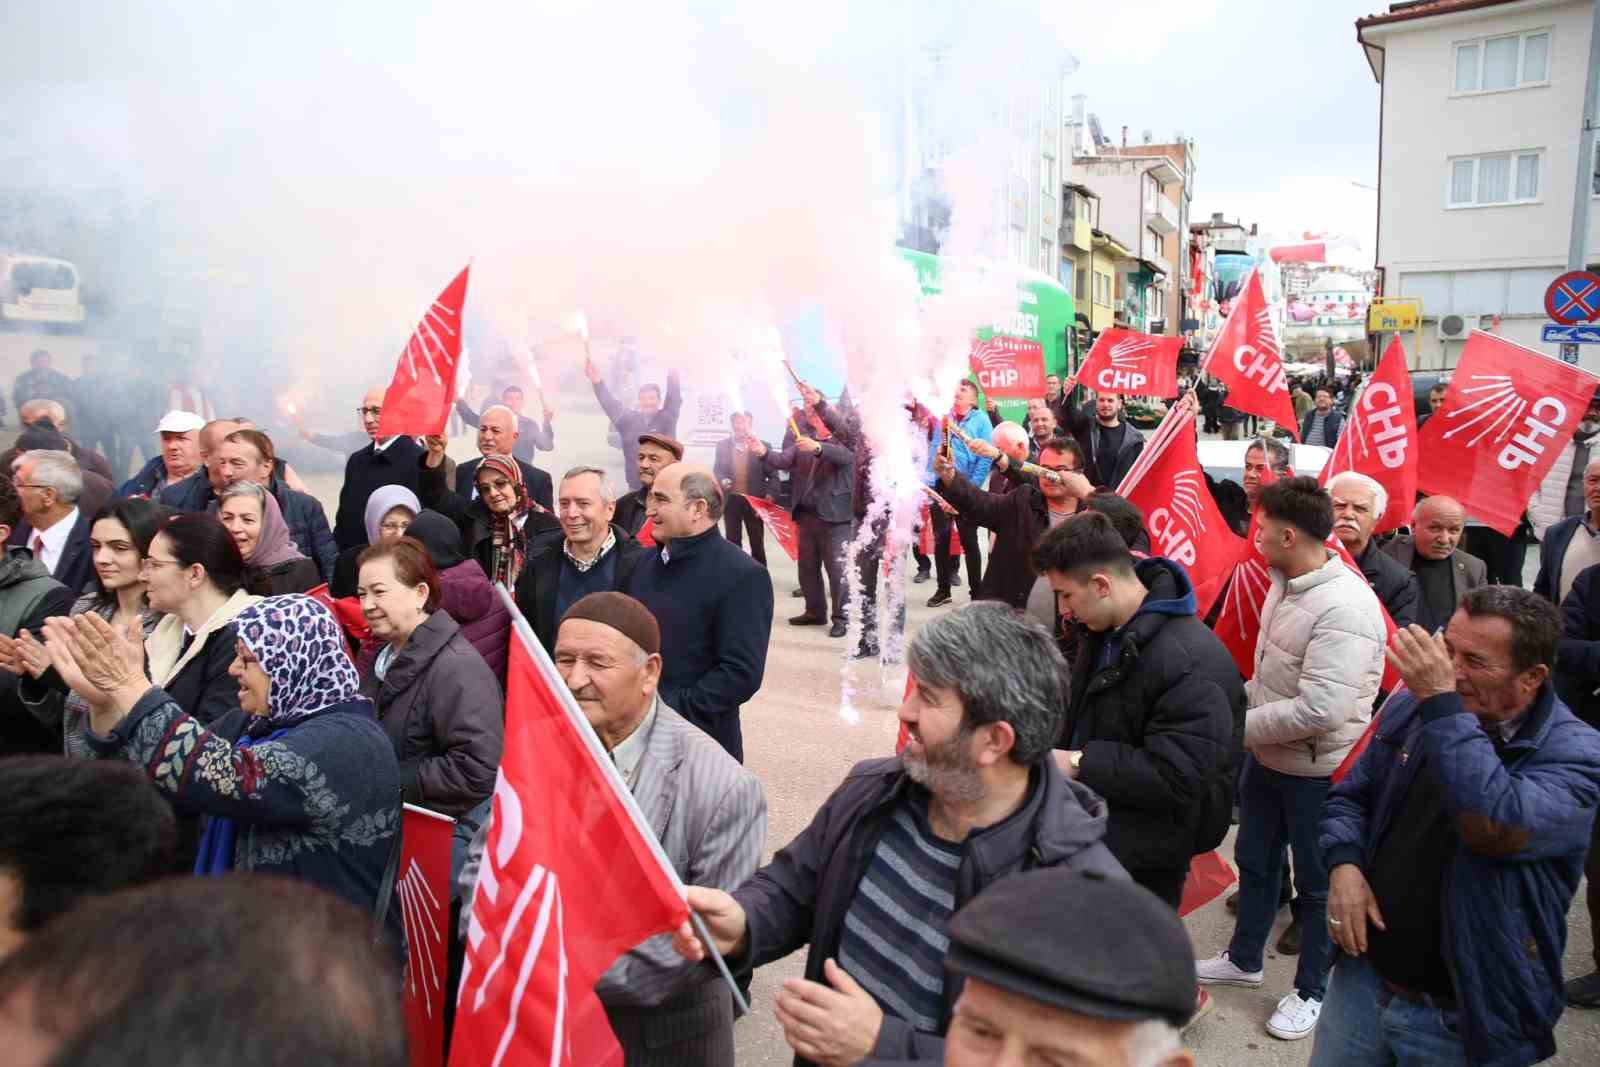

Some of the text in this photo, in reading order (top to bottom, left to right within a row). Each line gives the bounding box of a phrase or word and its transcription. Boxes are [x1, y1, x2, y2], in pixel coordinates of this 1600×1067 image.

[977, 368, 1019, 389] CHP
[1098, 368, 1147, 390] CHP
[1233, 344, 1289, 395] CHP
[1149, 507, 1196, 567] CHP
